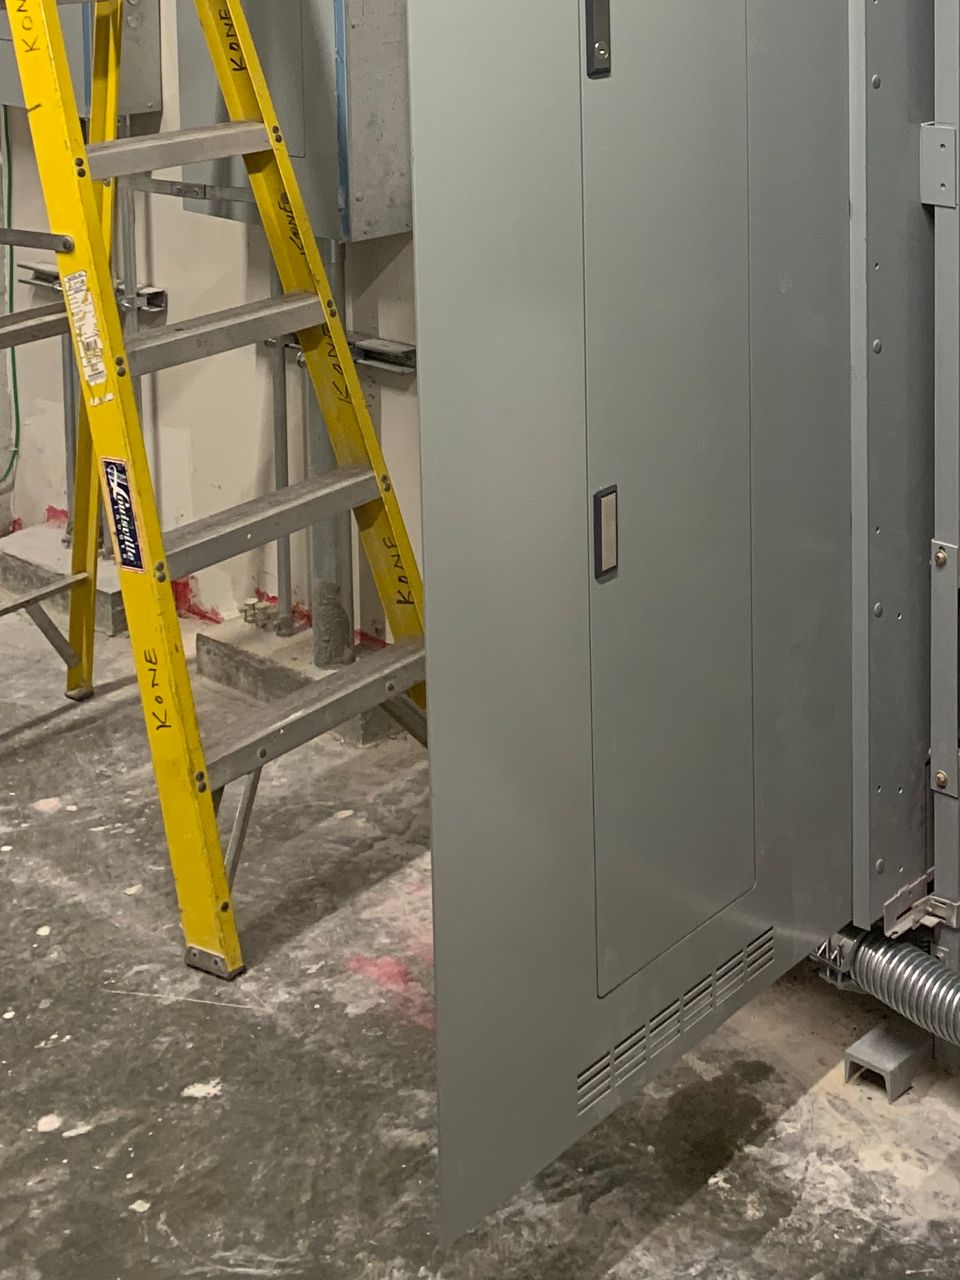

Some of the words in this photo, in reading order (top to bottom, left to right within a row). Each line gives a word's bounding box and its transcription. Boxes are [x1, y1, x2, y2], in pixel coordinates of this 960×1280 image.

[218, 8, 247, 72] KONE
[106, 464, 137, 561] Louisville
[143, 648, 172, 731] KONE
